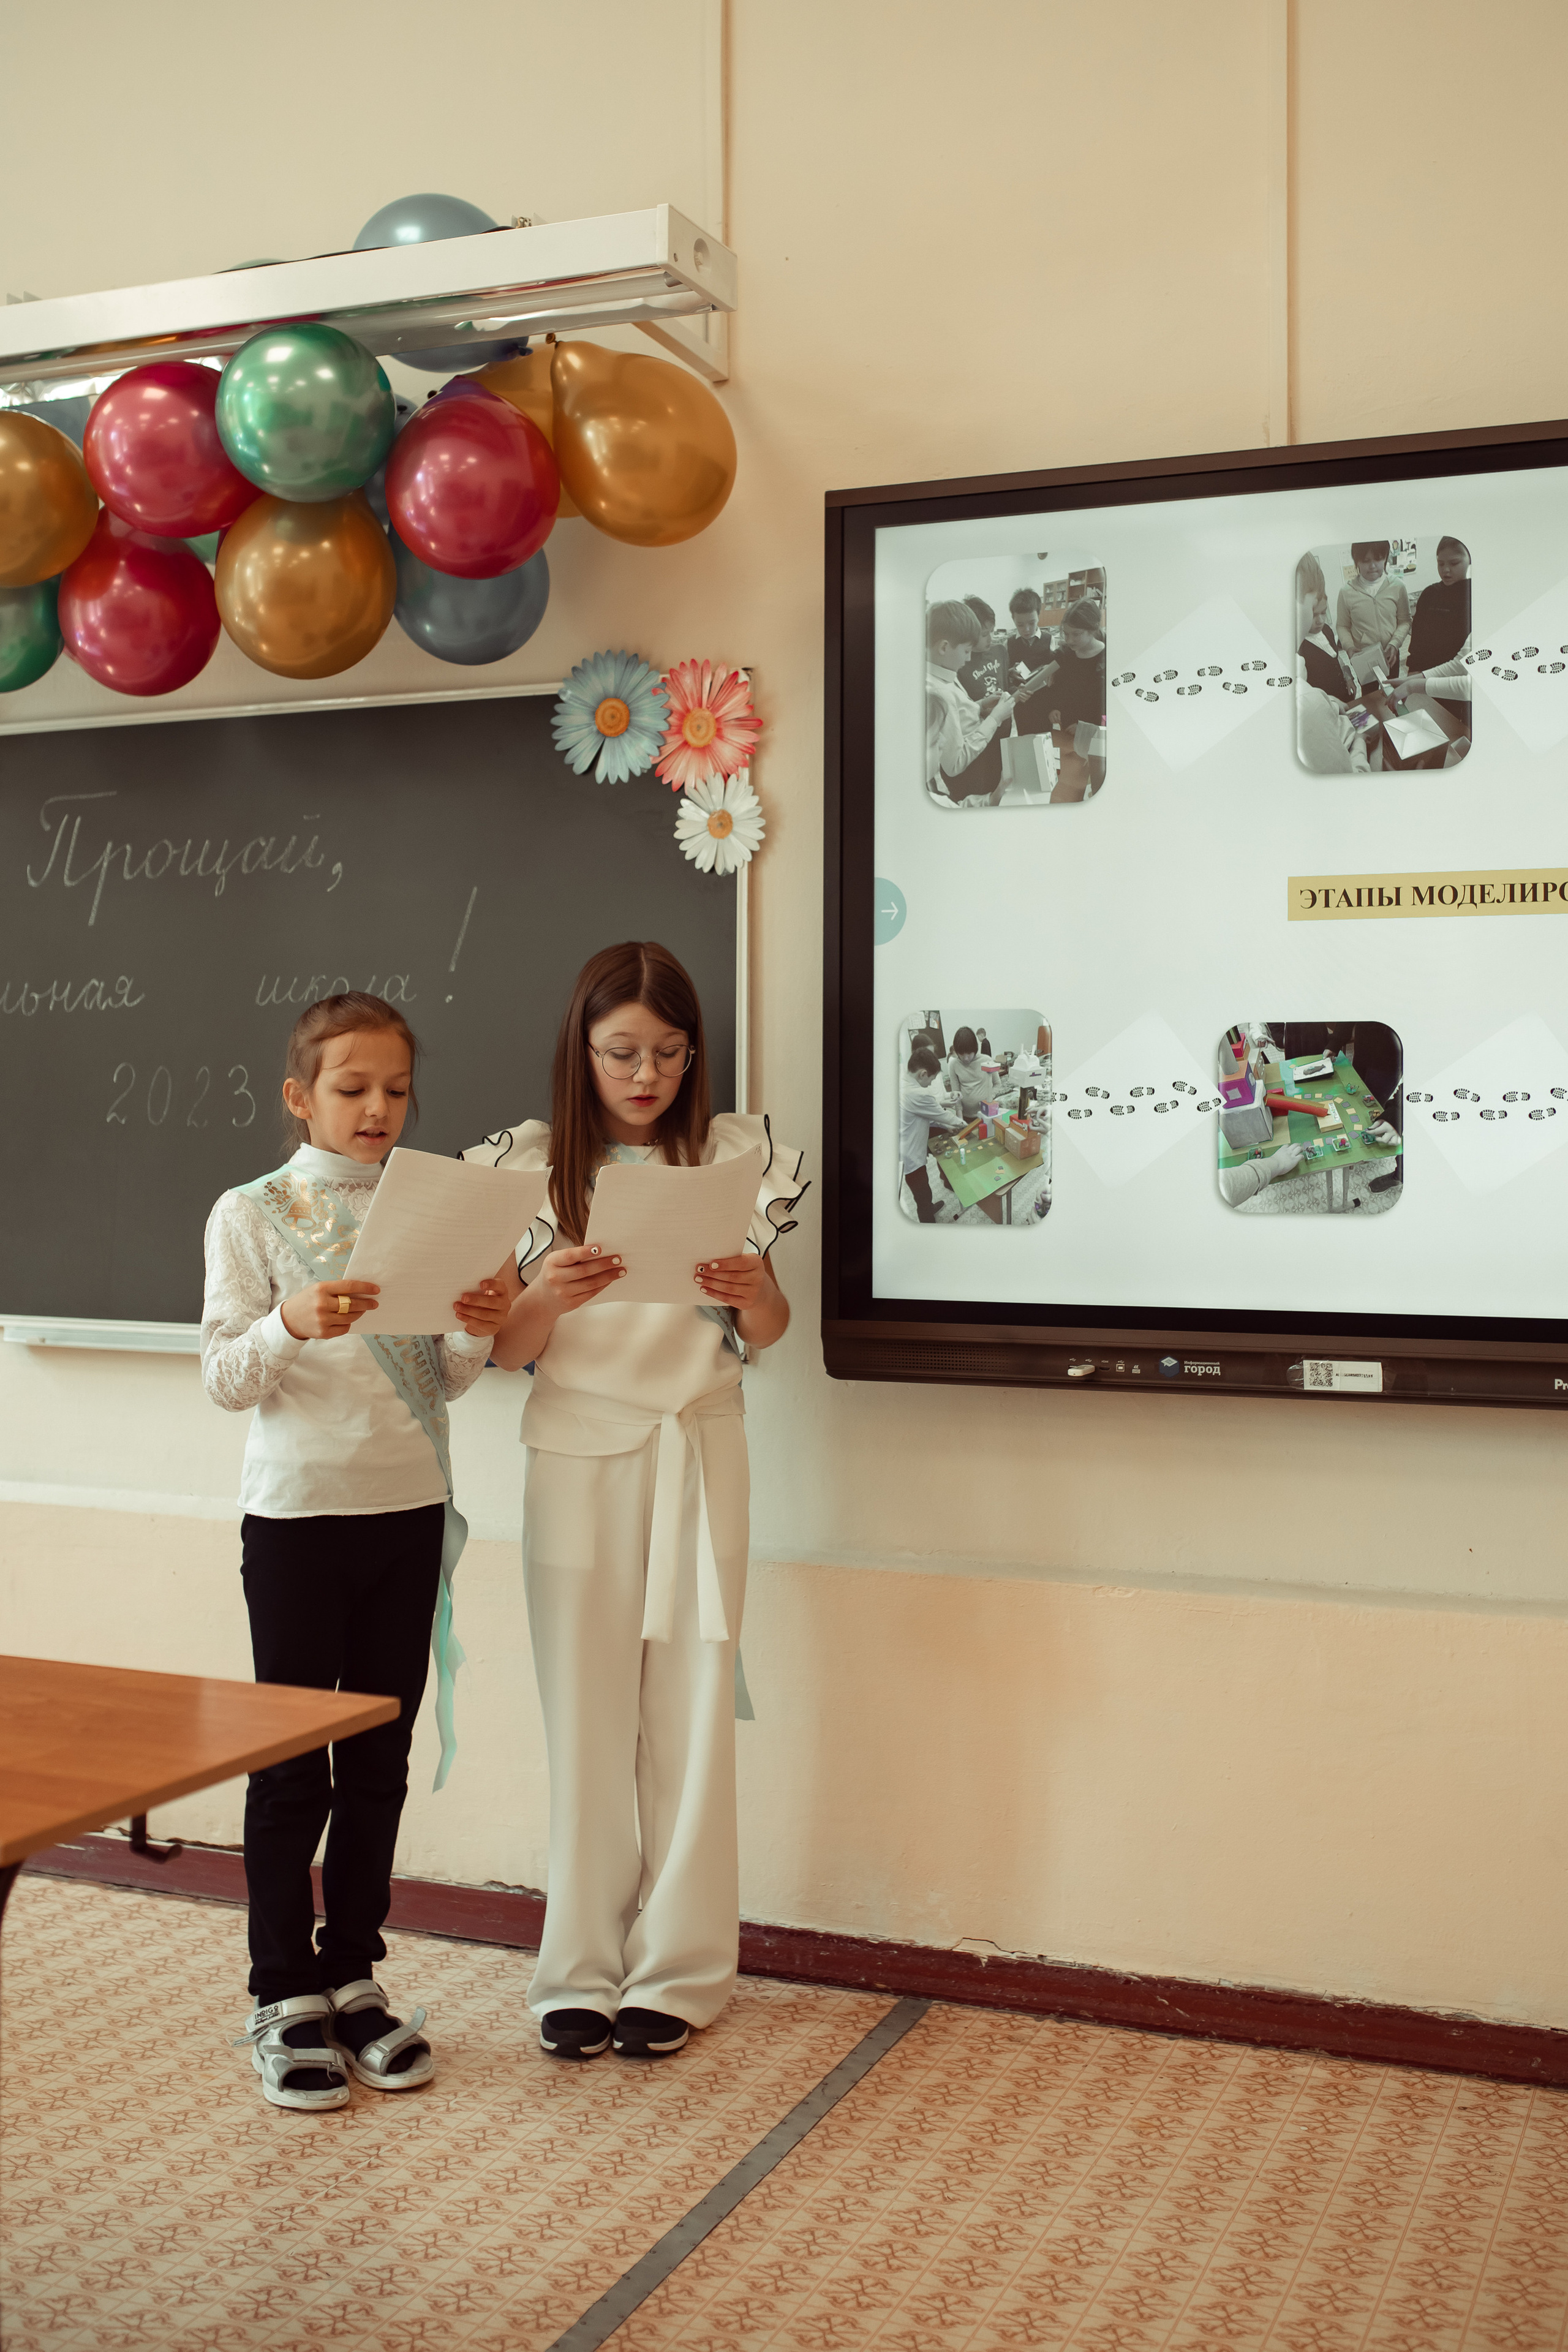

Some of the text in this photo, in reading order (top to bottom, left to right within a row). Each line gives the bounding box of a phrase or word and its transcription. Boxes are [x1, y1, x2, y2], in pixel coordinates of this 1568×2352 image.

[27, 791, 343, 925] Прощай,
[1299, 886, 1403, 910] ЭТАПЫ
[106, 1062, 256, 1127] 2023
[1184, 1365, 1221, 1376] город
[1554, 1378, 1568, 1390] Pr
